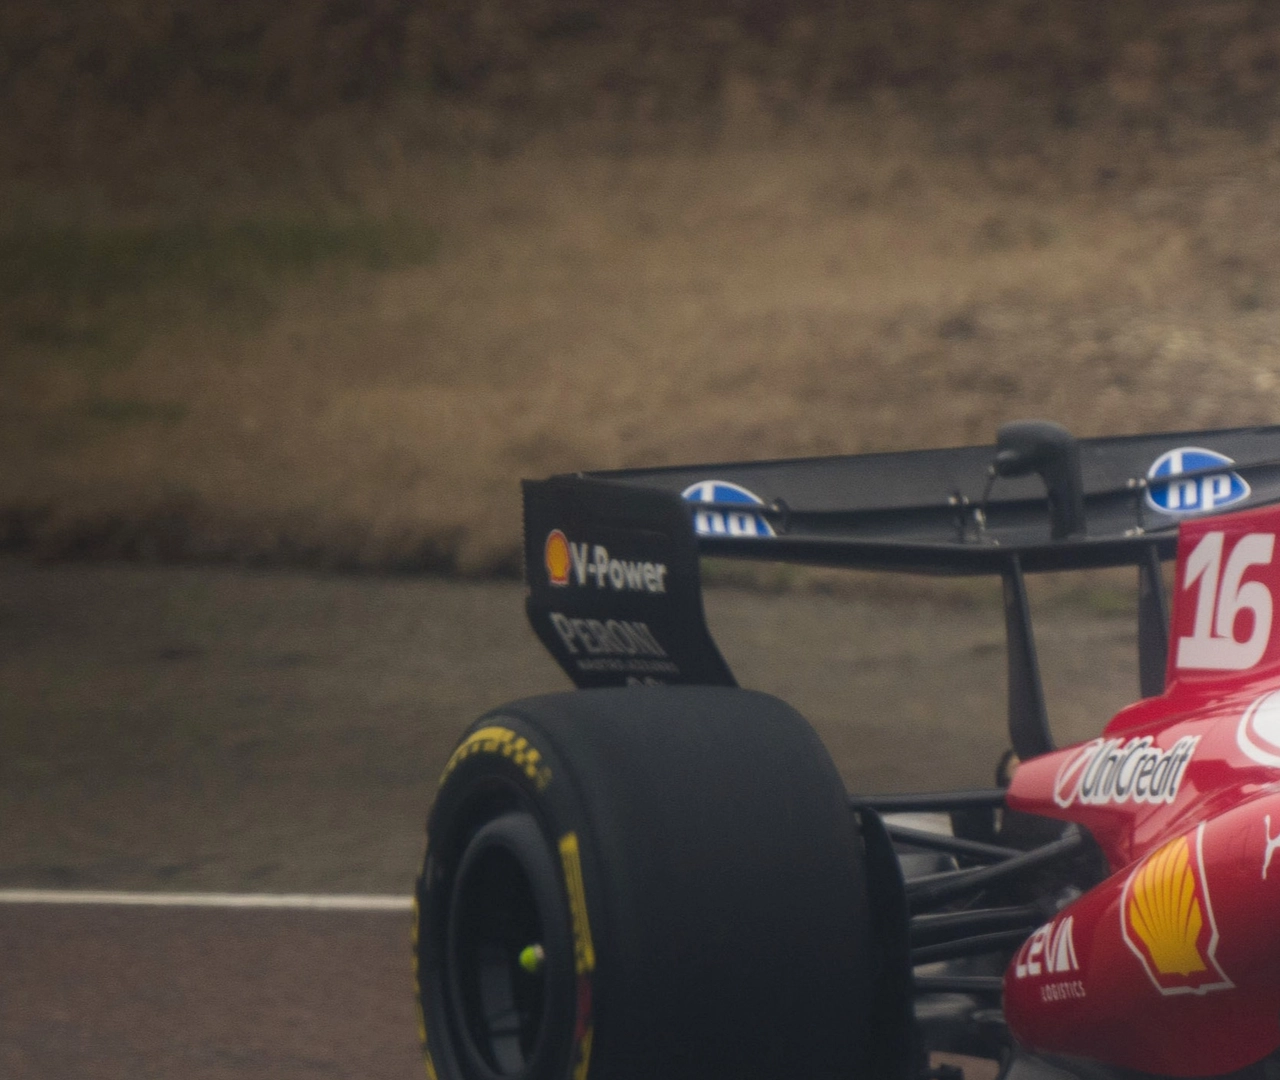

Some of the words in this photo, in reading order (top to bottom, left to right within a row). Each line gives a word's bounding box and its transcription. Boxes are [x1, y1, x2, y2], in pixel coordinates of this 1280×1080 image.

[1168, 451, 1232, 511] hp
[570, 541, 667, 593] V-Power
[1175, 530, 1276, 671] 16
[550, 612, 668, 657] PERONI
[1080, 736, 1200, 803] UniCredit
[1041, 980, 1086, 1002] LOGISTICS
